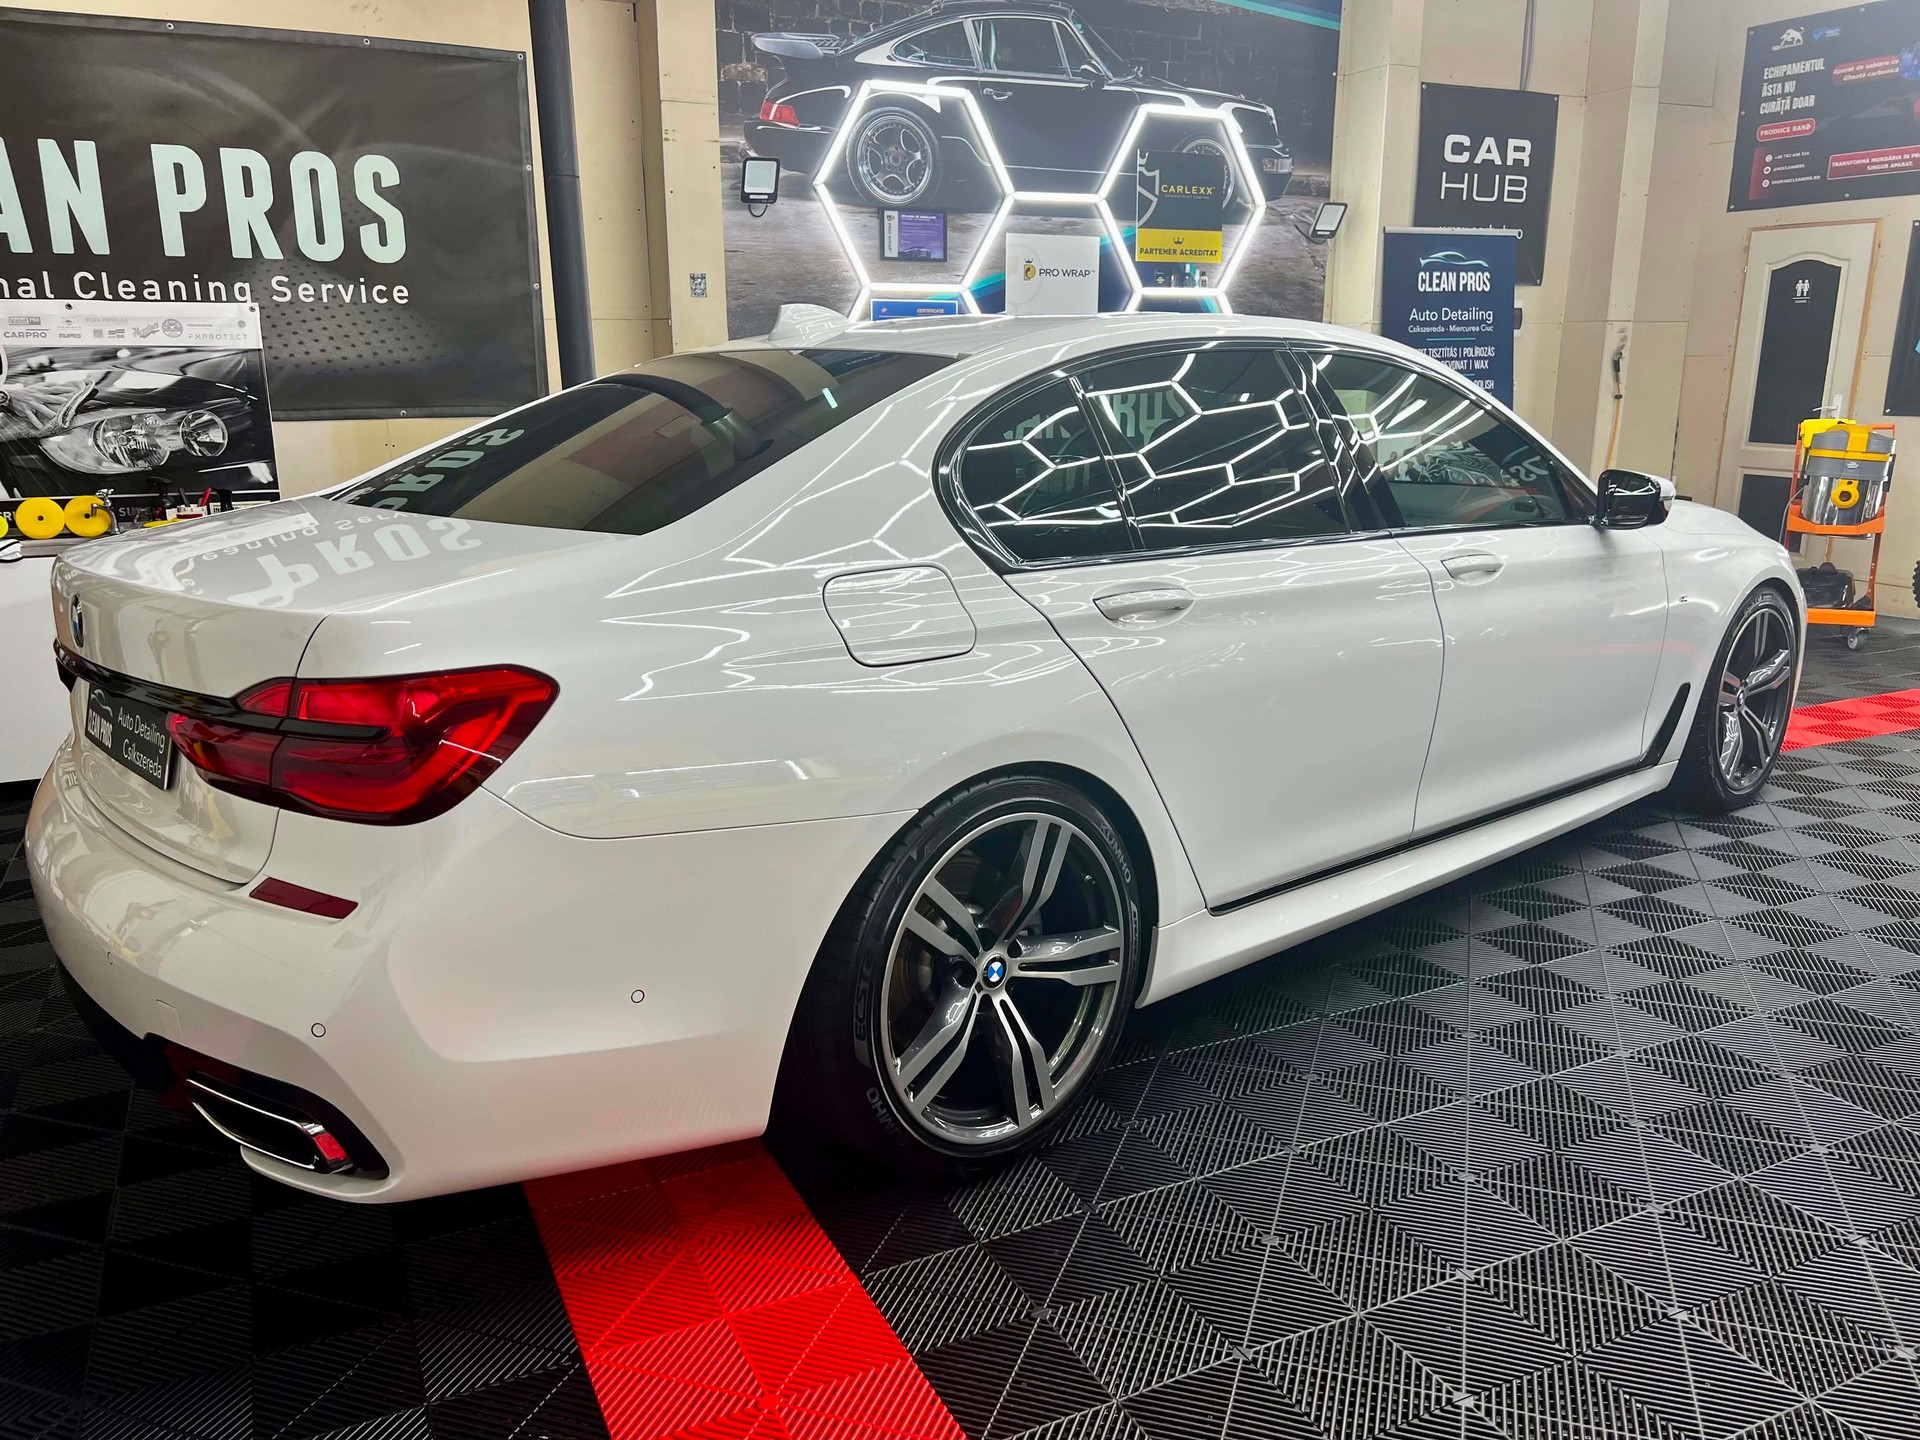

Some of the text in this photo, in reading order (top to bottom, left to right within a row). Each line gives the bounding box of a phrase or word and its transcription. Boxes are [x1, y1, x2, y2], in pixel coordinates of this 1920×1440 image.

[1763, 58, 1825, 80] ECHIPAMENTUL
[1784, 80, 1796, 94] NU
[1792, 94, 1816, 110] DOAR
[1760, 126, 1791, 137] PRODUCE
[1443, 133, 1532, 167] CAR
[1161, 184, 1213, 195] CARLEXX
[1440, 171, 1528, 203] HUB
[150, 143, 407, 264] PROS
[1139, 247, 1218, 257] PARTENER ACREDITAT
[1039, 268, 1091, 278] PRO WRAP
[1417, 271, 1491, 293] CLEAN PROS
[73, 271, 252, 303] Cleaning
[271, 275, 410, 305] Service
[1409, 306, 1494, 324] Auto Detailing
[3, 331, 48, 339] CARPRO
[1480, 323, 1494, 332] Ciuc
[1473, 359, 1489, 370] WAX
[87, 708, 113, 749] CLEAN PROS
[117, 706, 166, 755] Auto Detailing
[1100, 822, 1132, 884] KUMHO
